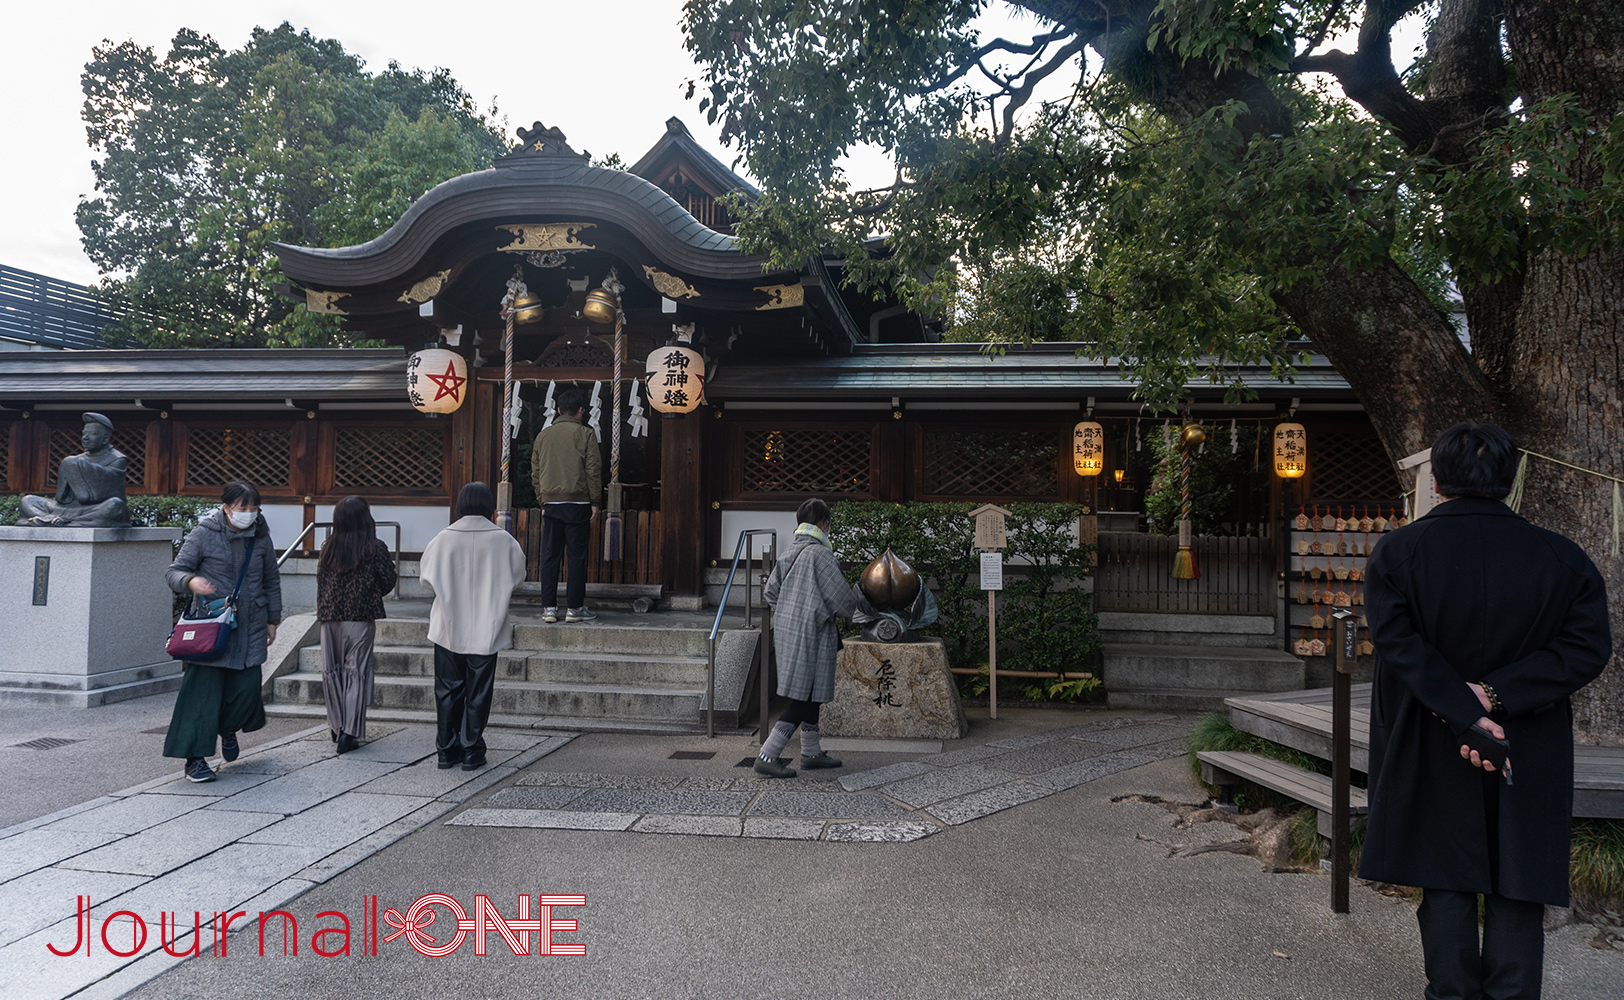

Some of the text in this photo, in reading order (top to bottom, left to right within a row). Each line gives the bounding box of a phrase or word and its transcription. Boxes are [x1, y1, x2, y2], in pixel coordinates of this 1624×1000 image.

[662, 350, 690, 407] 御神燈
[1075, 429, 1083, 469] 地主社
[1276, 430, 1284, 471] 地主社
[872, 659, 903, 708] 厄除桃
